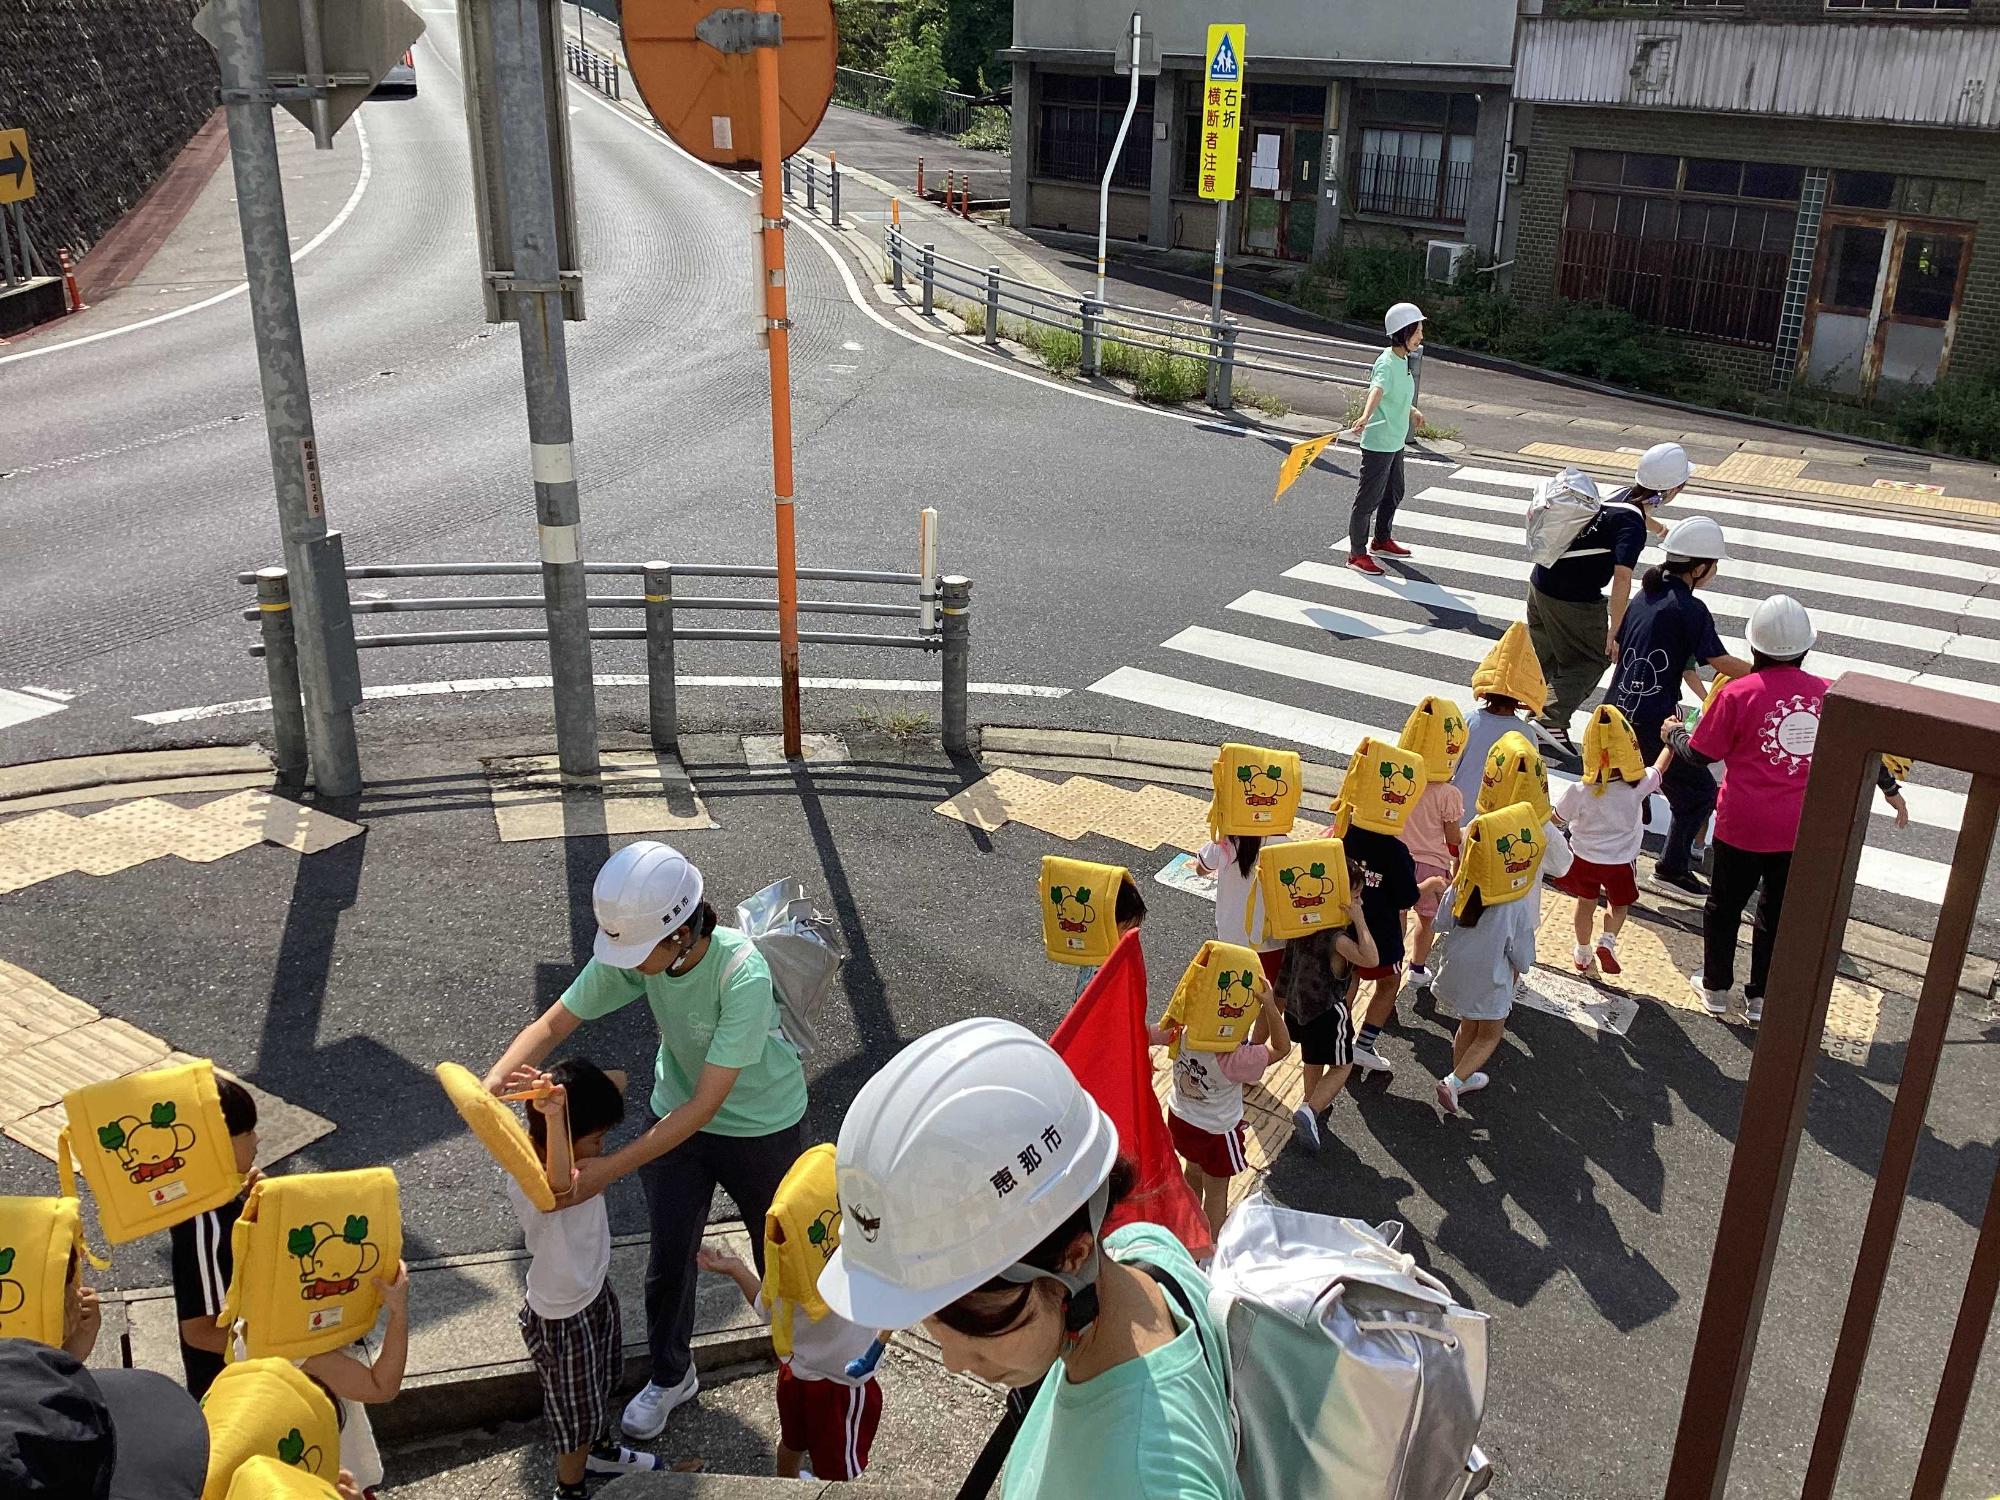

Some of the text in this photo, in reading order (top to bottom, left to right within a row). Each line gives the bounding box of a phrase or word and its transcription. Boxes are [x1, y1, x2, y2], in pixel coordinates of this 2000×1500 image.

[1202, 86, 1222, 193] 横断者注意
[1222, 87, 1238, 129] 右折
[989, 1124, 1062, 1199] 恵那市
